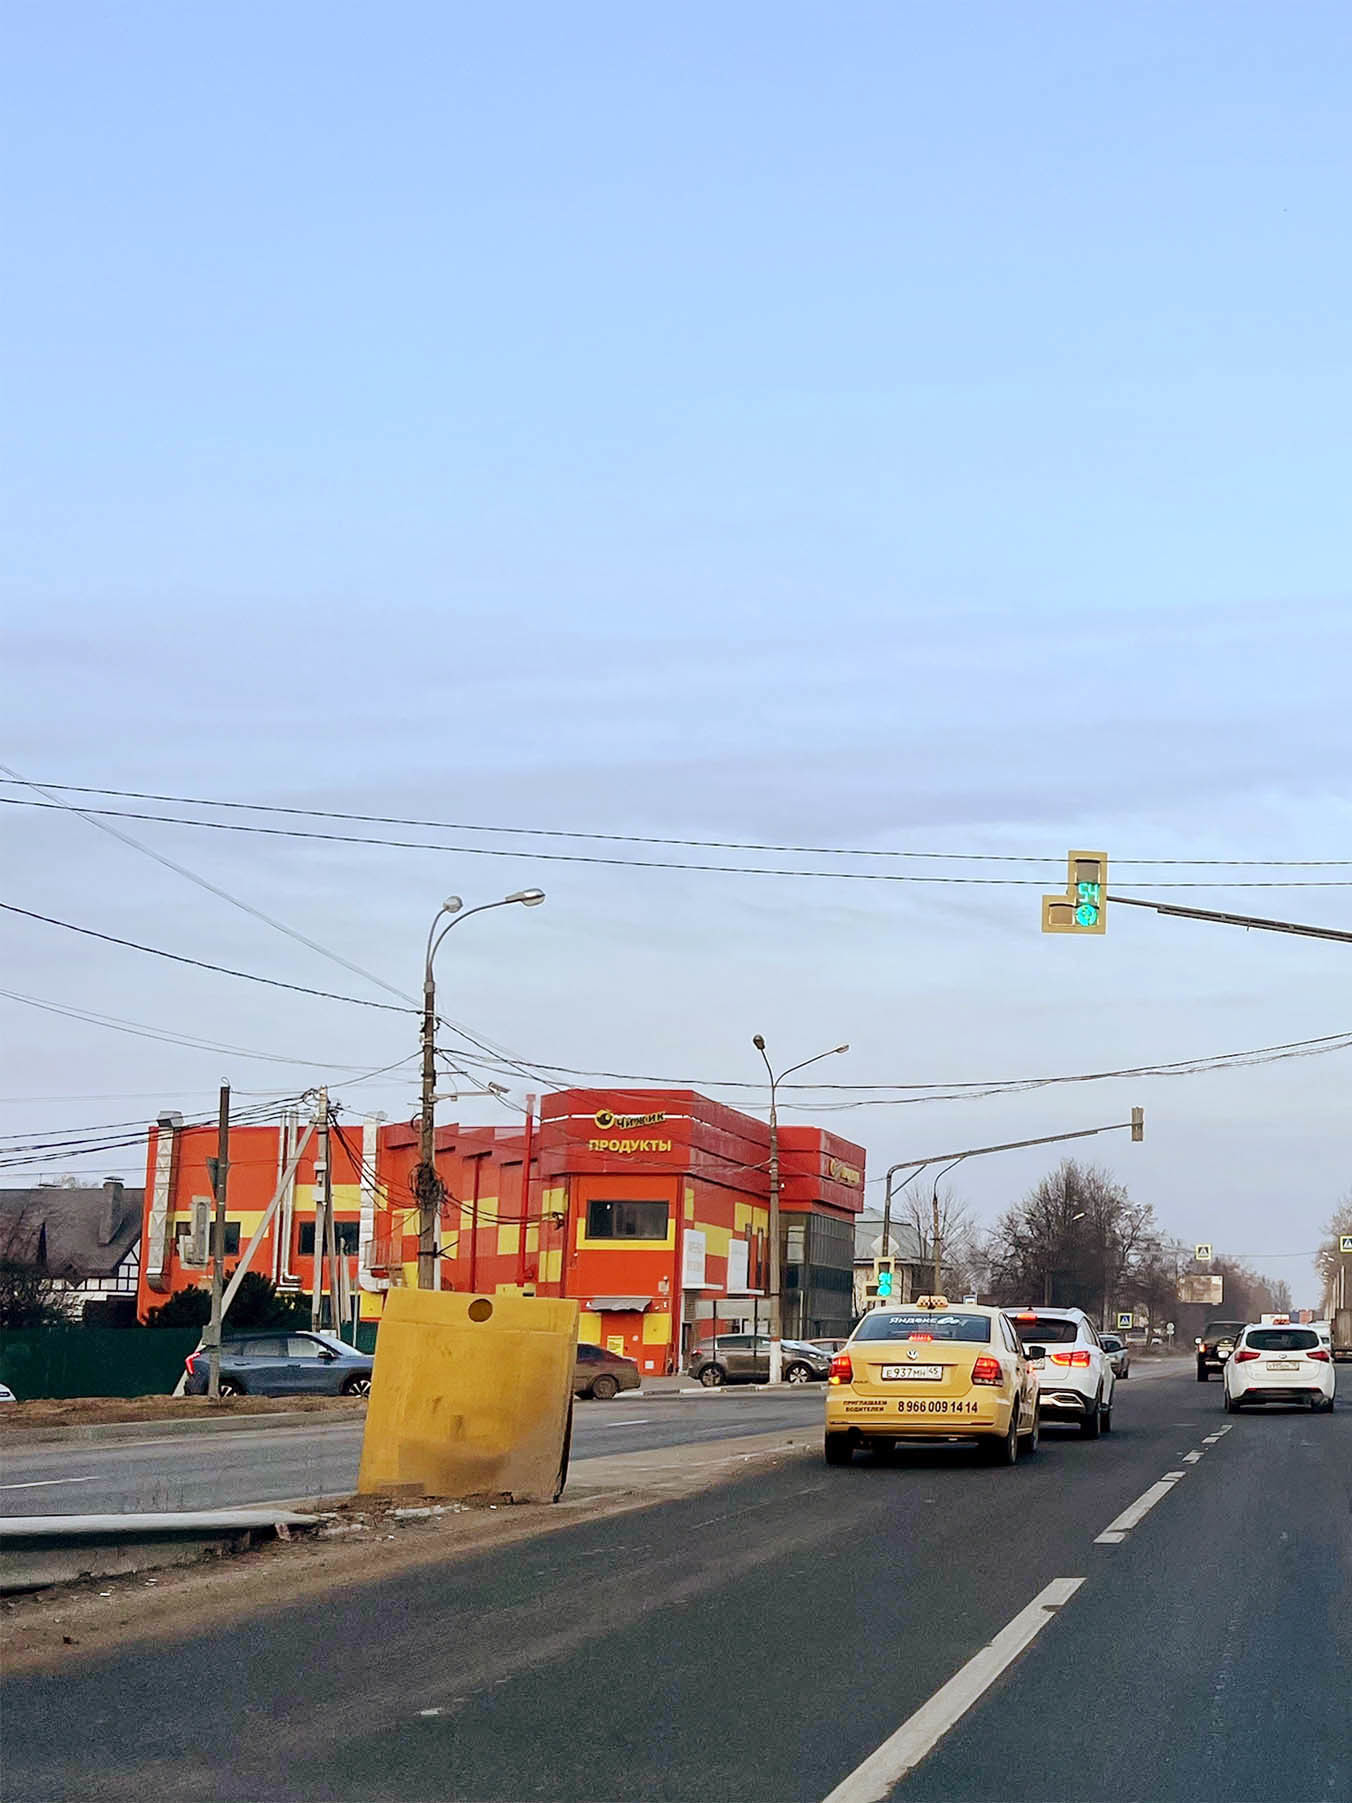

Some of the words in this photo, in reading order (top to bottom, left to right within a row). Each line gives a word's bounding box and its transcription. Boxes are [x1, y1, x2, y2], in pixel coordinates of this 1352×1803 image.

[1078, 883, 1100, 903] 54
[588, 1139, 672, 1153] ПРОДУКТЫ
[898, 1401, 905, 1413] 8
[906, 1401, 926, 1413] 966
[928, 1401, 948, 1413] 009
[951, 1401, 963, 1413] 14
[966, 1401, 978, 1414] 14
